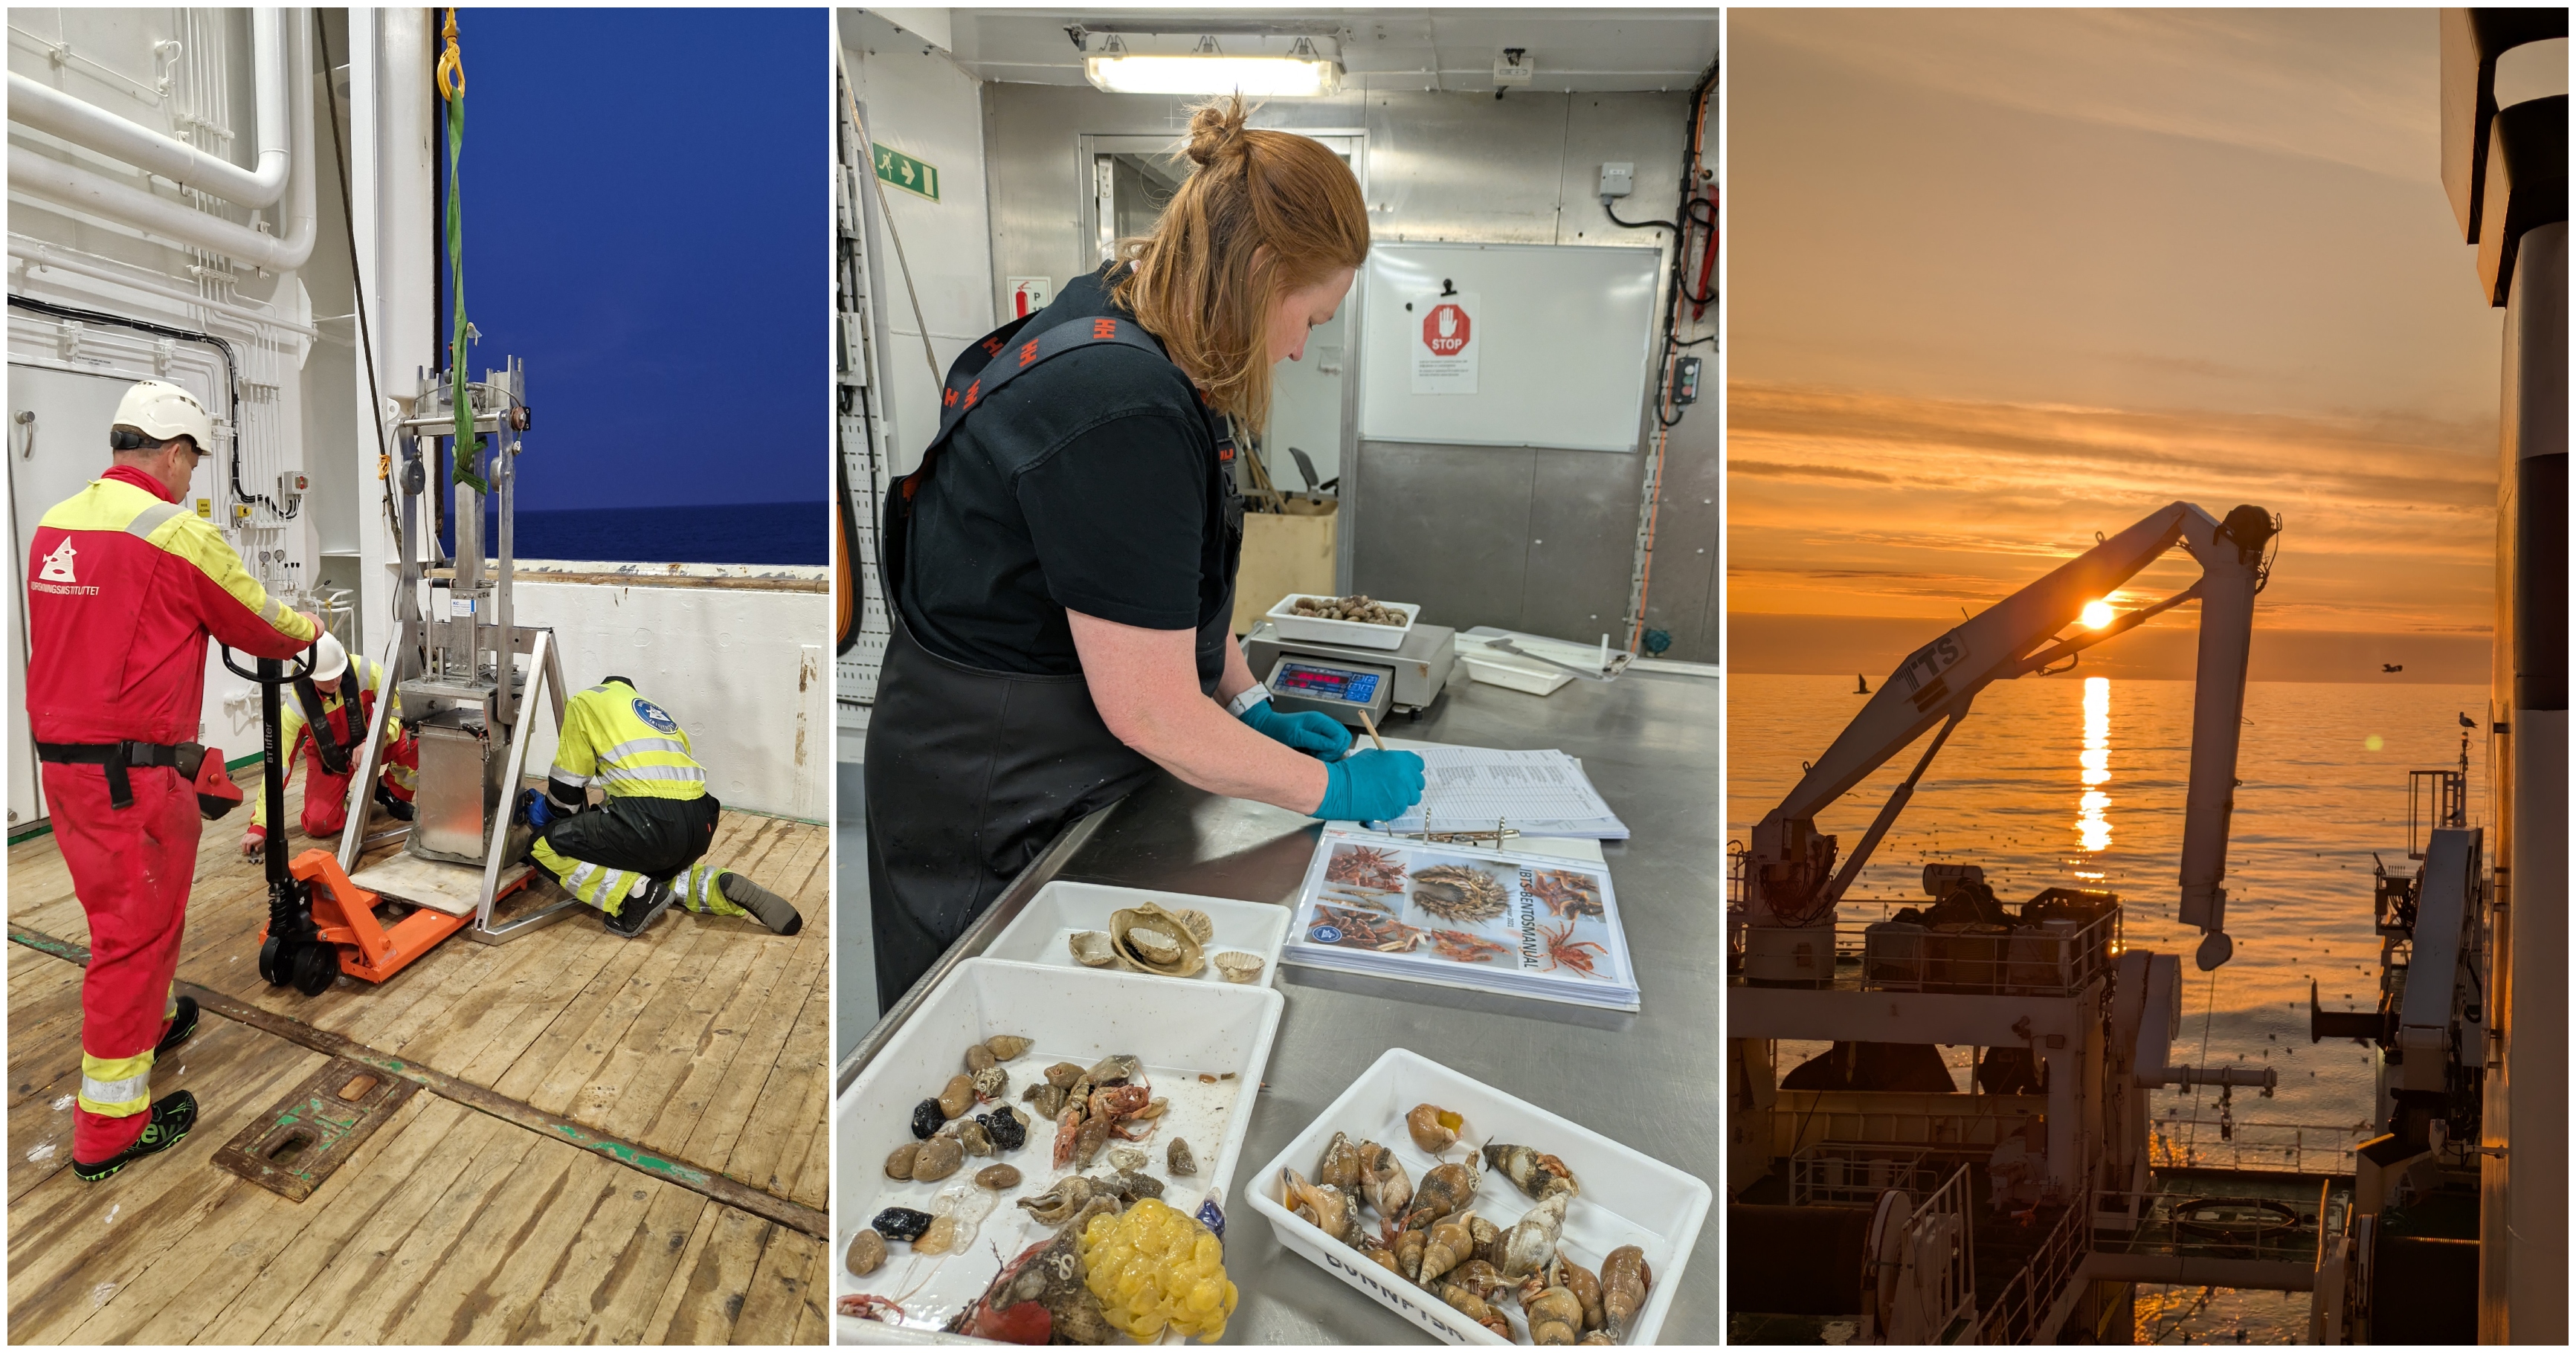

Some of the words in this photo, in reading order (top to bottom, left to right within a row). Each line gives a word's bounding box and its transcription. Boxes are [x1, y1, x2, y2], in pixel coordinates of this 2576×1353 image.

[1034, 292, 1040, 301] P
[1432, 338, 1463, 350] STOP
[266, 751, 274, 763] BT
[1507, 917, 1515, 928] 2021
[1519, 868, 1539, 968] IBTS-BENTOSMANUAL
